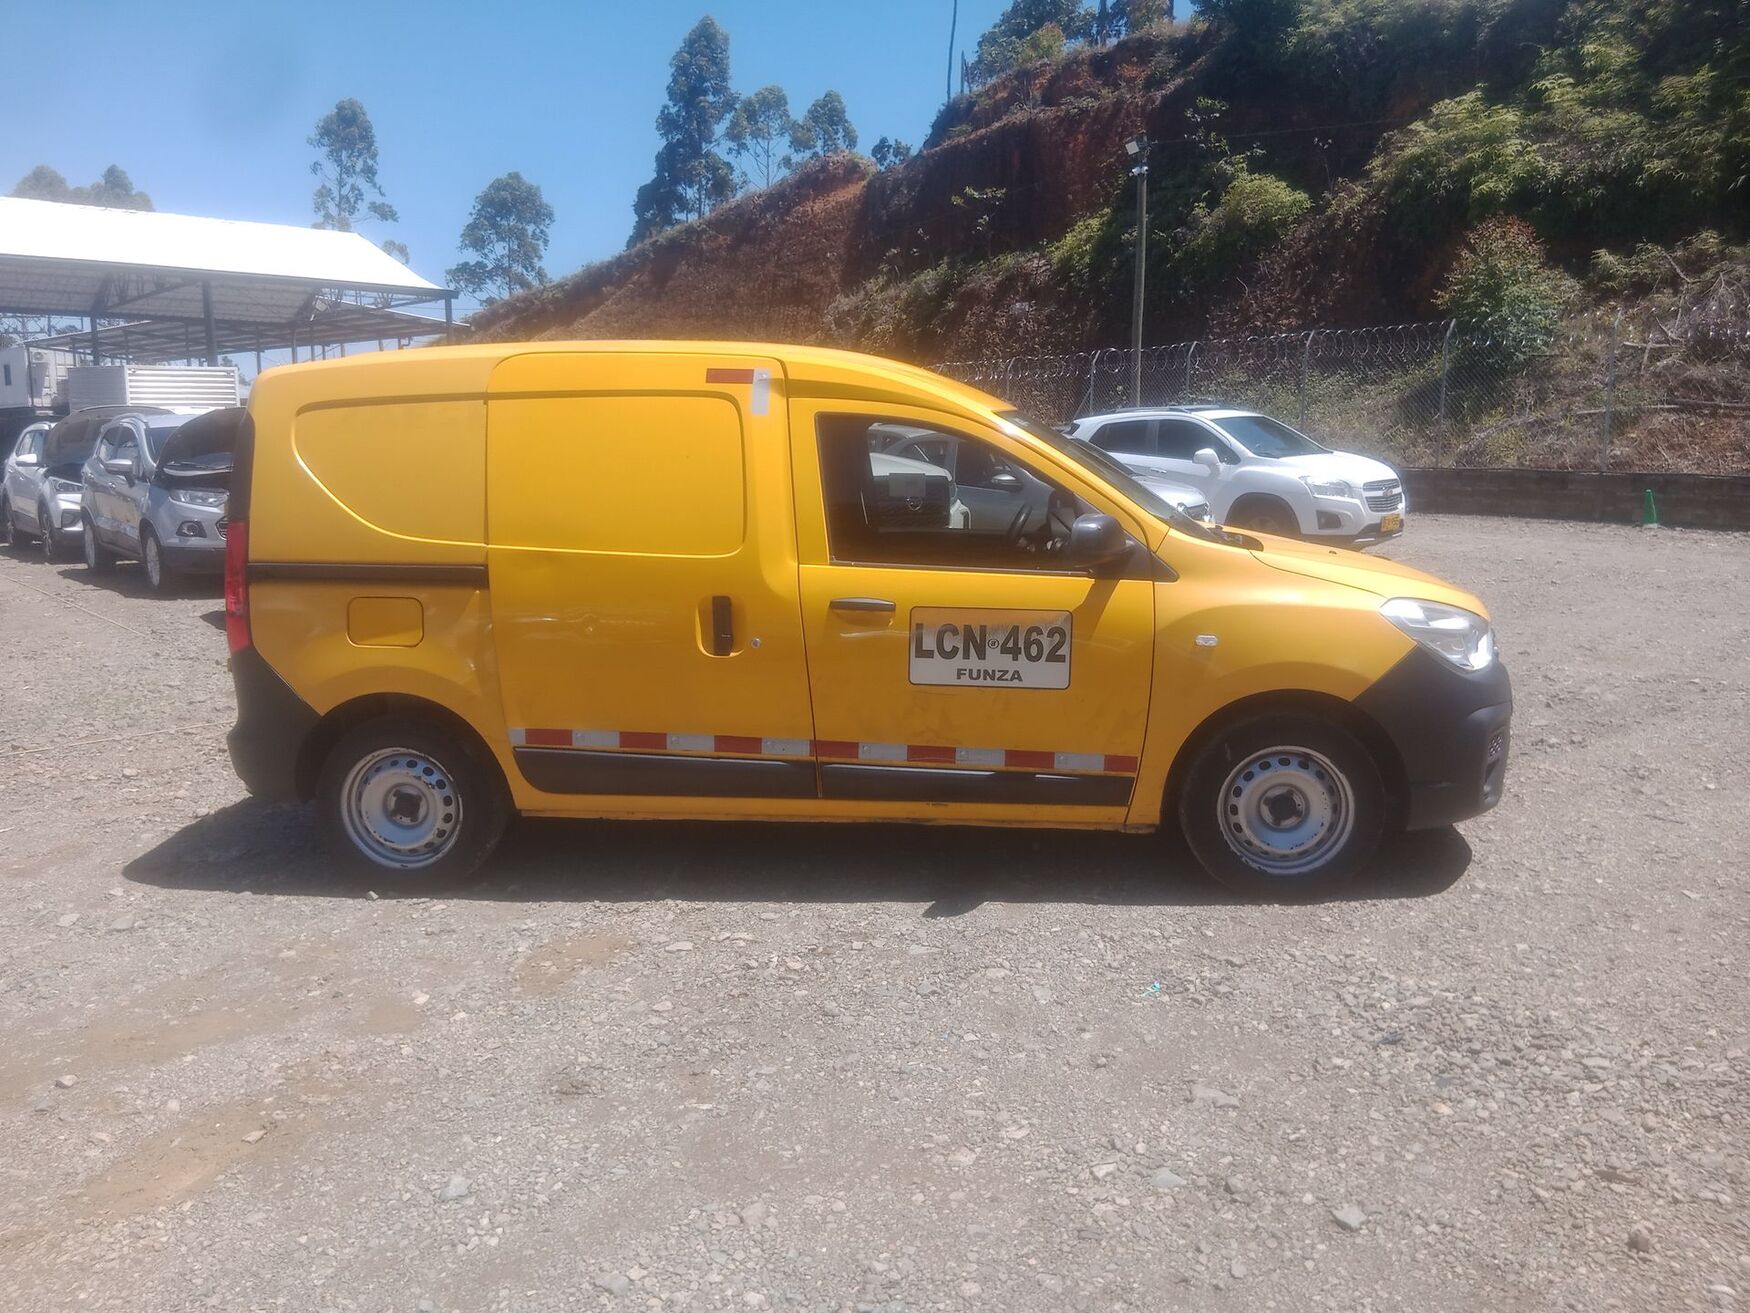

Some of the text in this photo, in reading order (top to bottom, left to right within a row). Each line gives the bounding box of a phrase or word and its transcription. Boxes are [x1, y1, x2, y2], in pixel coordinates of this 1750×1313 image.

[914, 623, 1067, 663] LCN 462
[956, 668, 1023, 682] FUNZA
